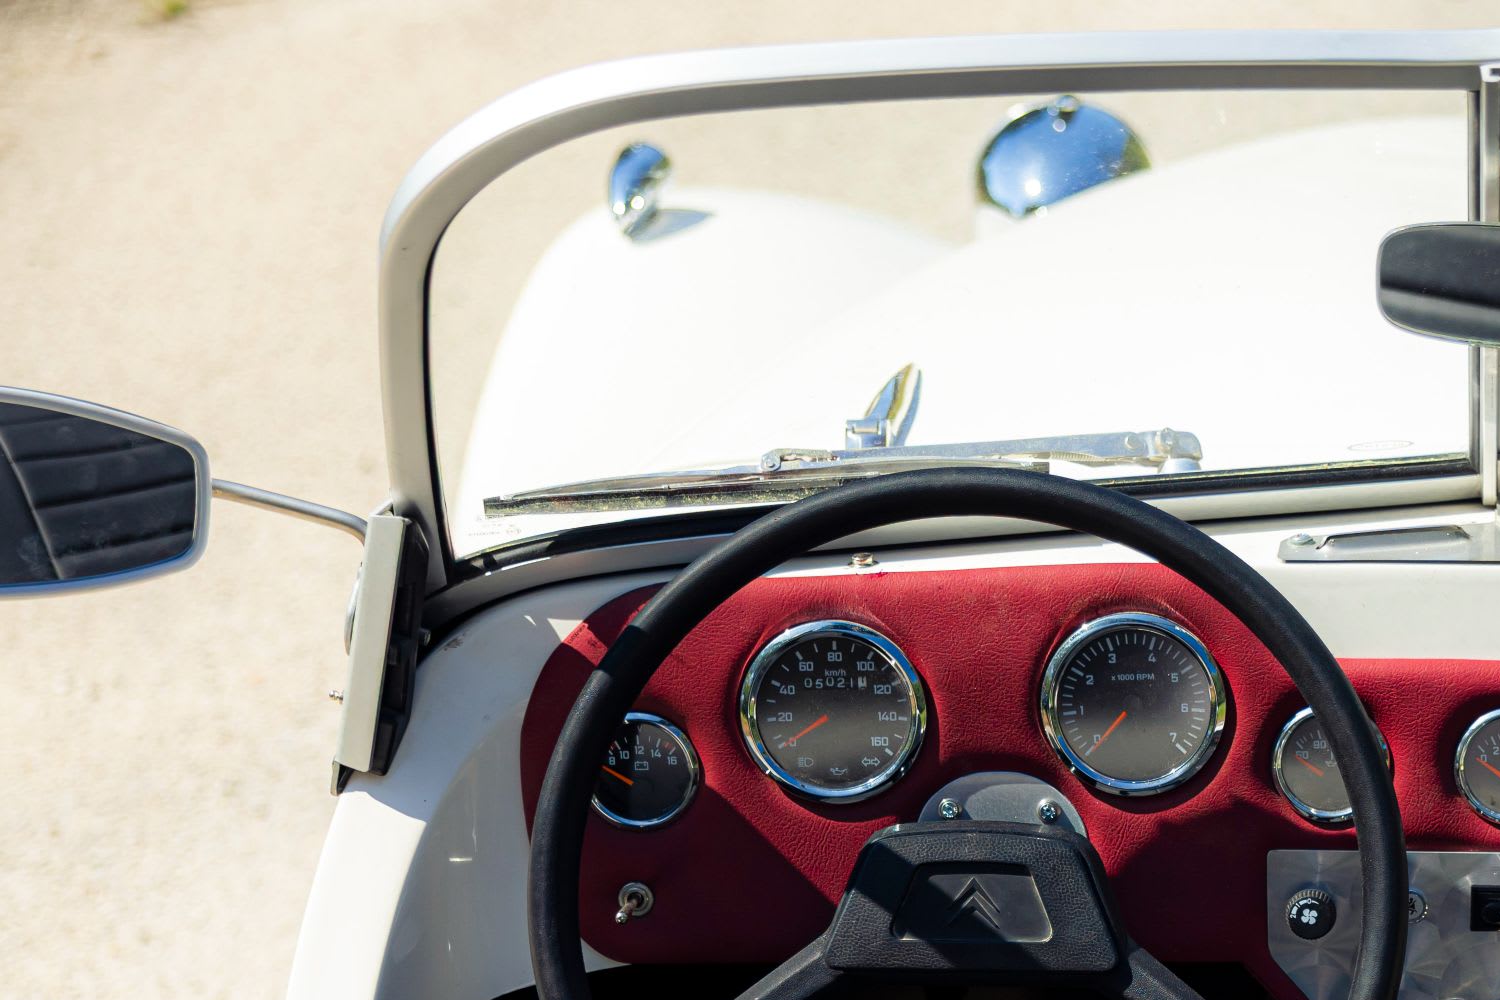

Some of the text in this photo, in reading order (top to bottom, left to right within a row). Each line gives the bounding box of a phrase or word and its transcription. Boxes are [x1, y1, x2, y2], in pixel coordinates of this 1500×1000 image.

[827, 652, 842, 661] 80
[1109, 654, 1116, 663] 3
[1148, 653, 1156, 662] 4
[799, 662, 814, 671] 60
[857, 662, 874, 671] 100
[825, 669, 846, 677] km/h
[1171, 673, 1178, 682] 5
[1086, 675, 1094, 685] 2
[780, 685, 795, 695] 40
[874, 685, 891, 694] 120
[1181, 704, 1188, 712] 6
[778, 712, 792, 722] 20
[878, 712, 897, 721] 140
[871, 737, 888, 746] 160
[1170, 733, 1177, 742] 7
[1313, 740, 1326, 749] 90
[635, 746, 644, 754] 12
[651, 749, 661, 758] 14
[1493, 747, 1499, 755] 2
[620, 751, 629, 759] 10
[609, 757, 615, 765] 8
[668, 757, 677, 765] 16
